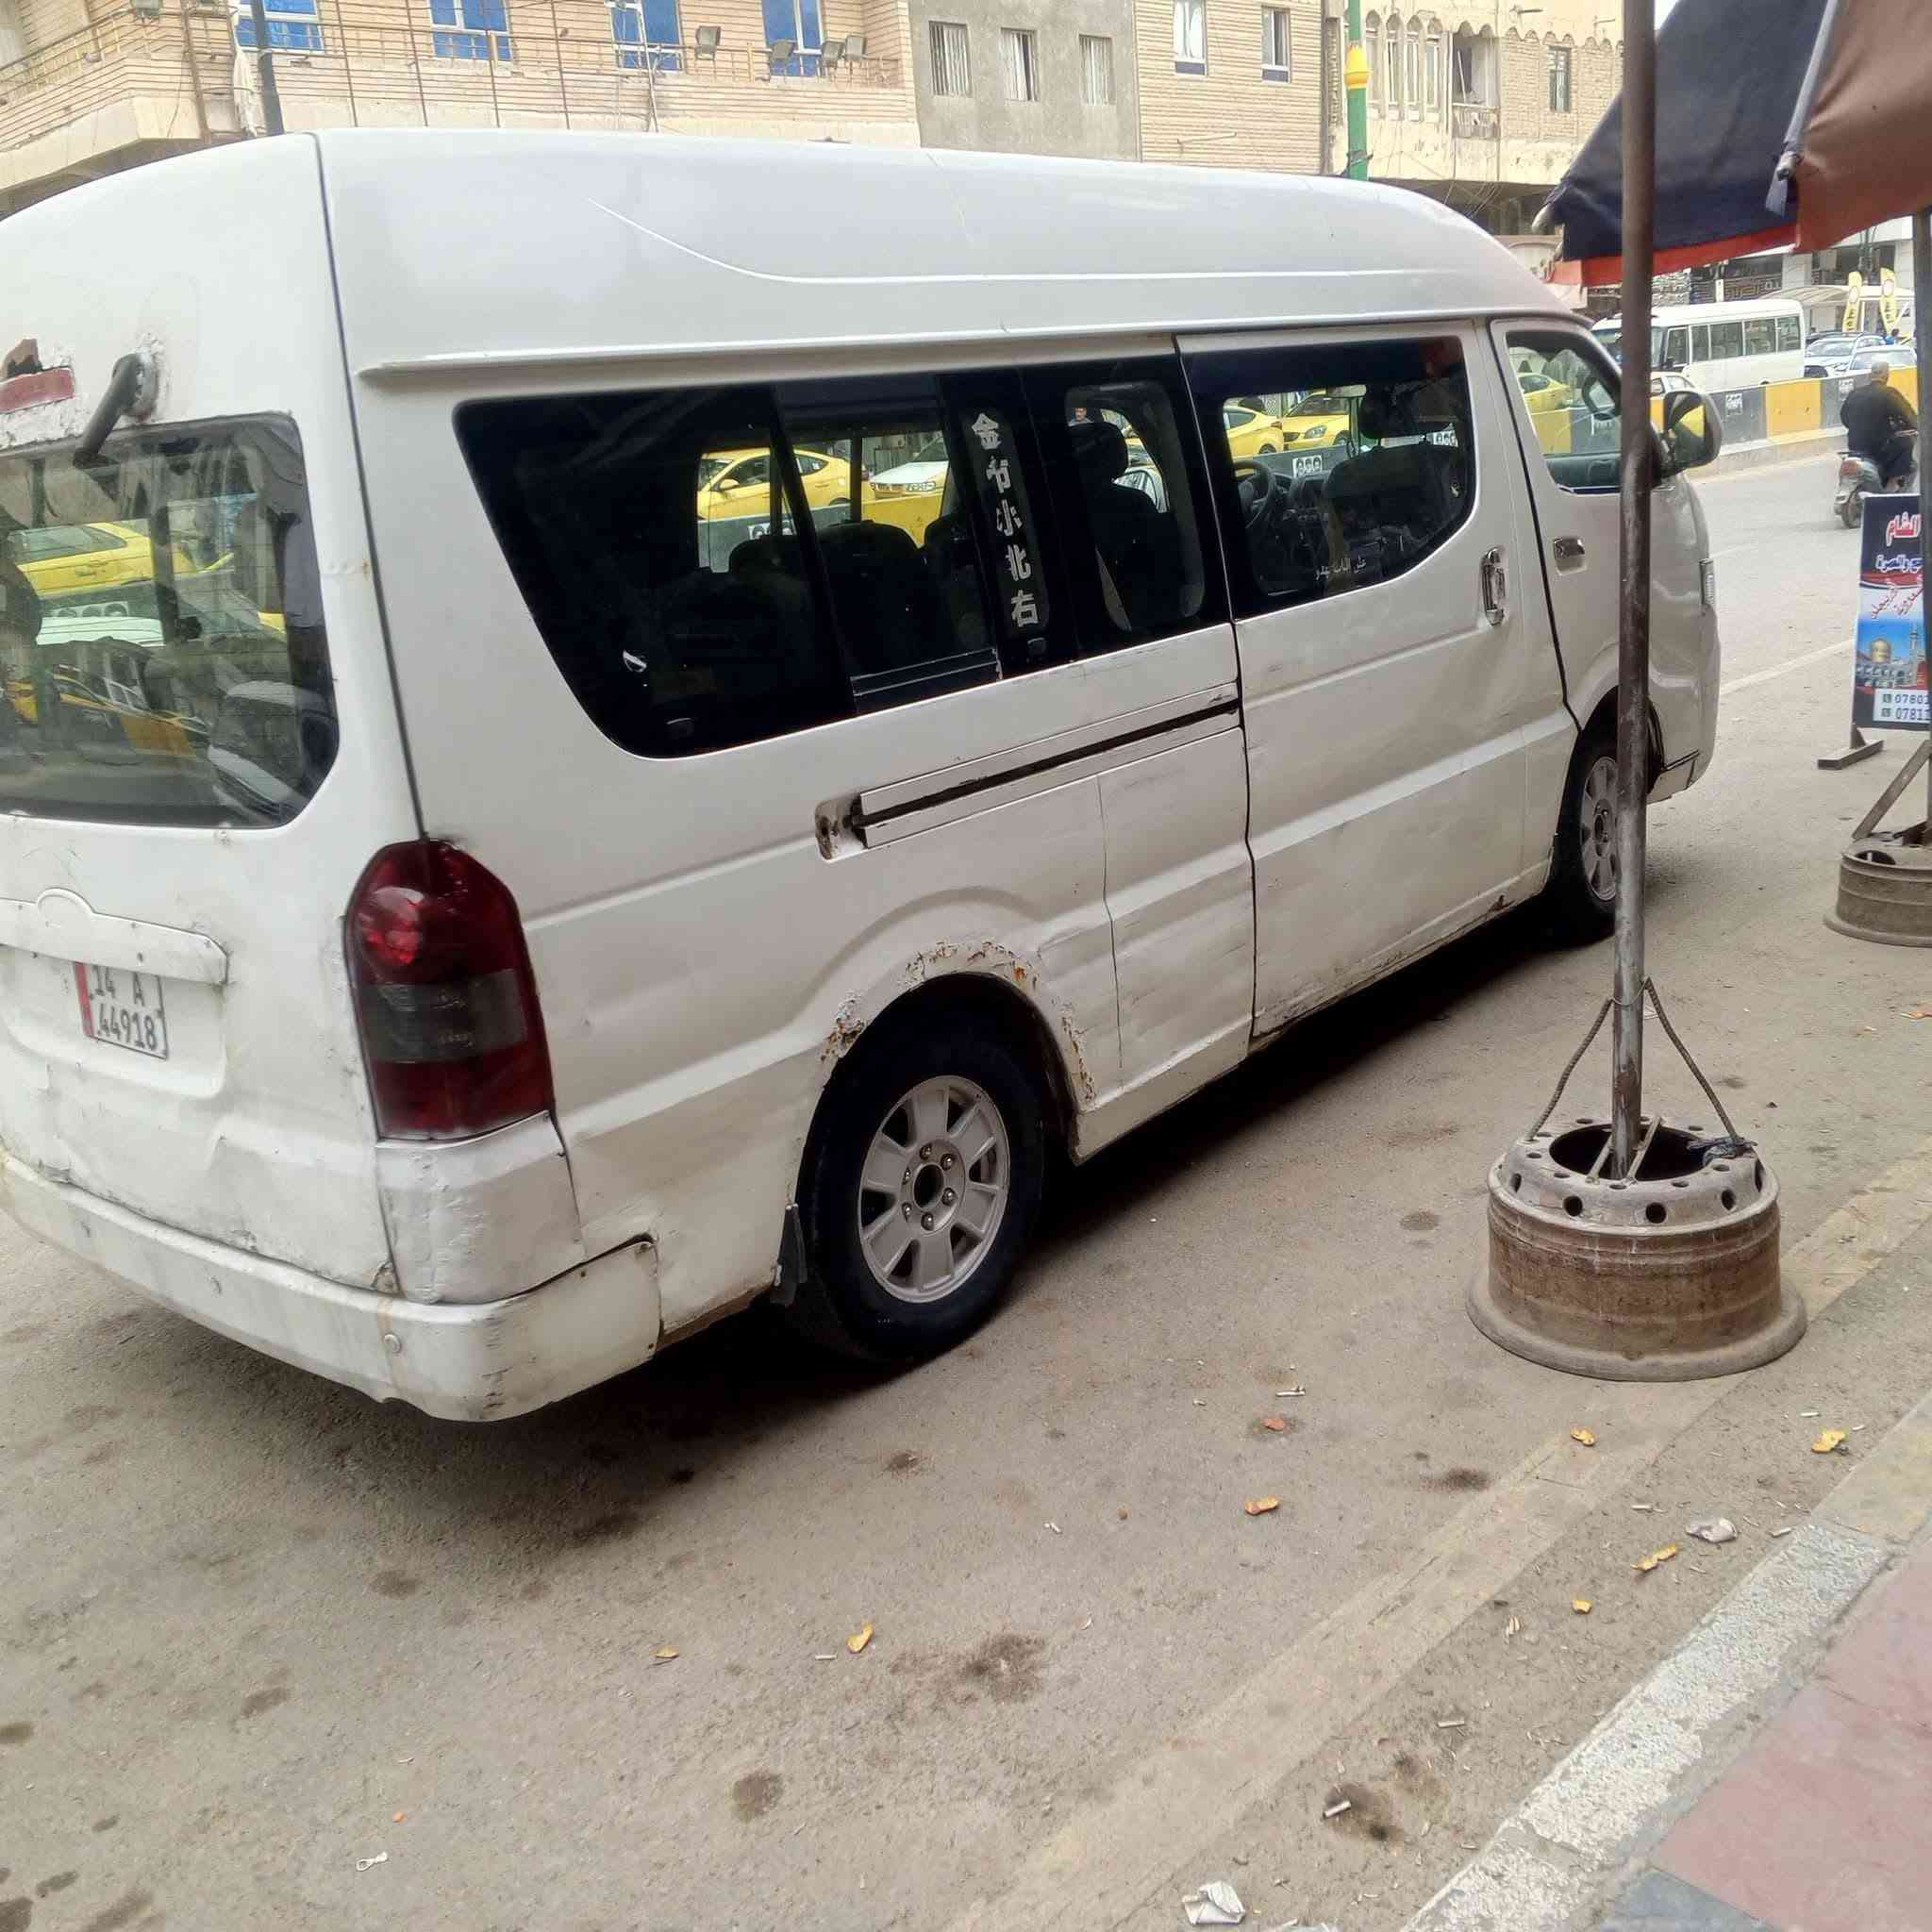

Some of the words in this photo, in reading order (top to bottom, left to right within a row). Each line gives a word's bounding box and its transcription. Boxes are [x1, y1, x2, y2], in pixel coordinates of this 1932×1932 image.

[92, 964, 115, 998] 14
[132, 971, 145, 1007] A
[99, 1003, 158, 1050] 44918
